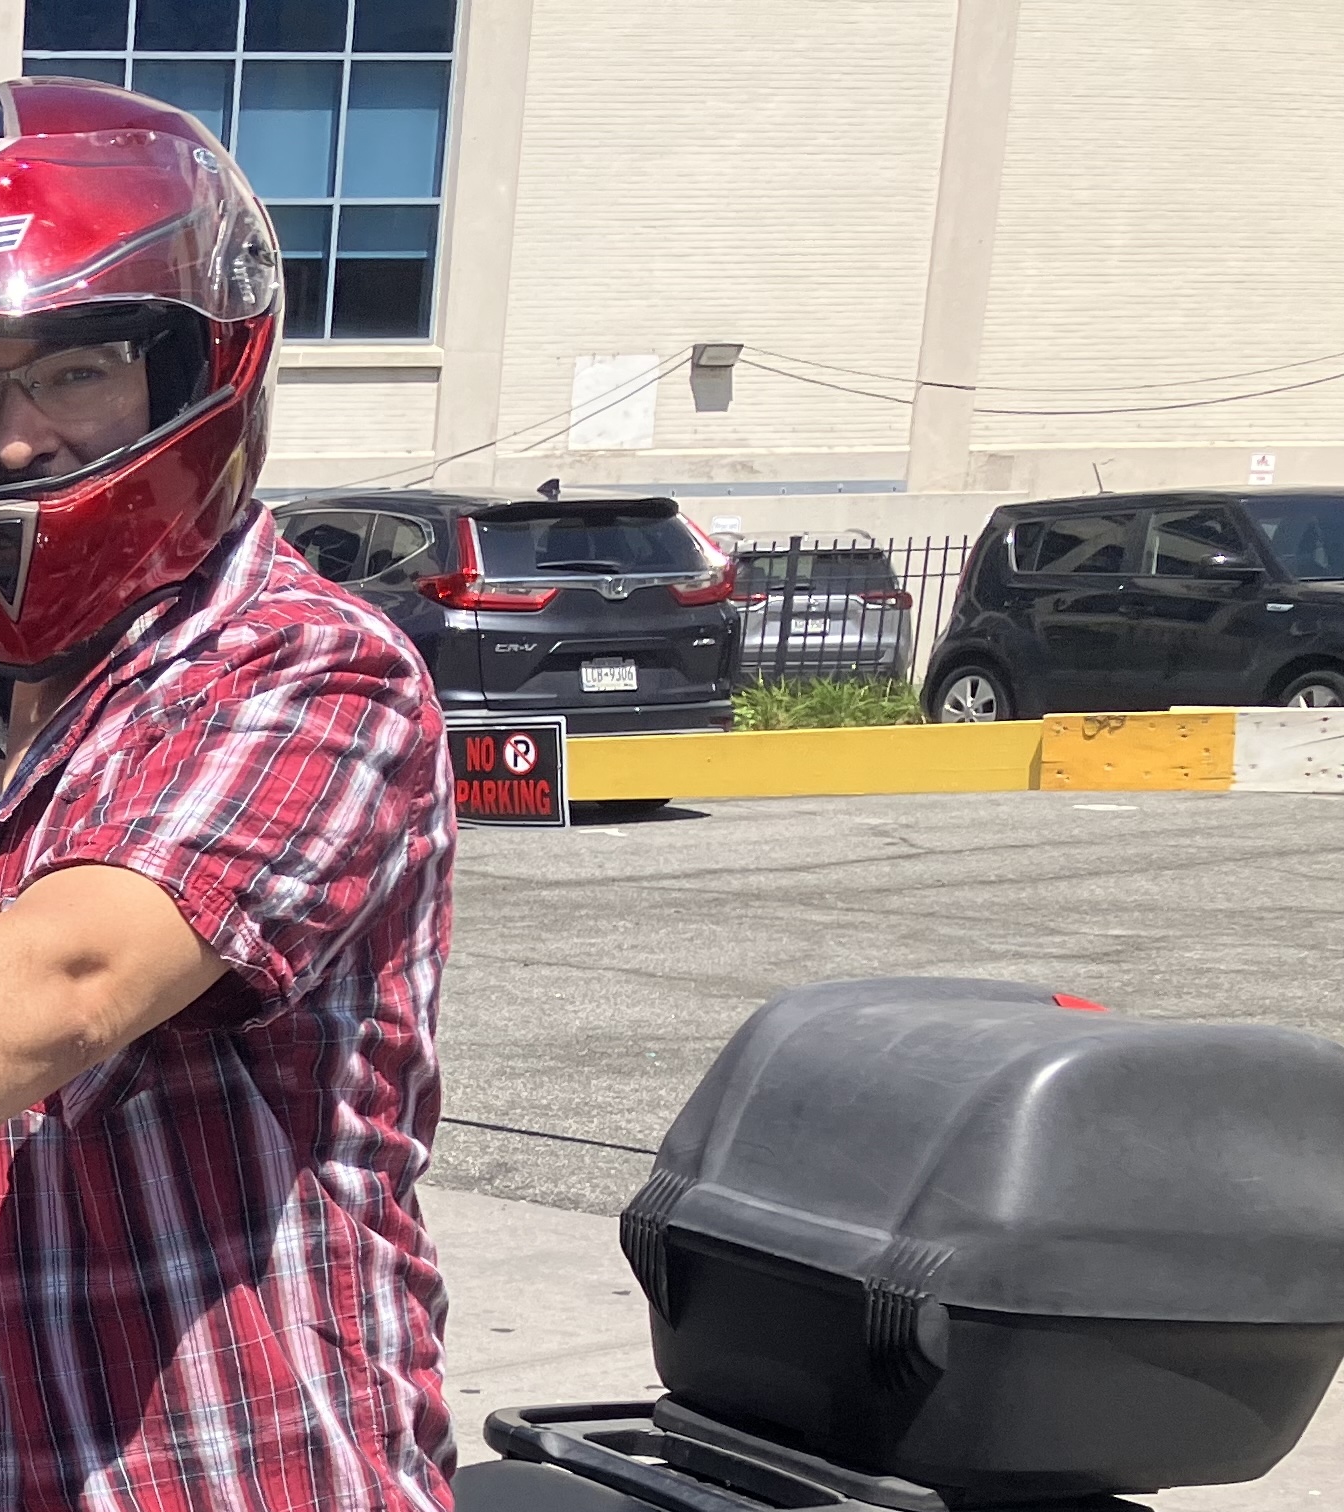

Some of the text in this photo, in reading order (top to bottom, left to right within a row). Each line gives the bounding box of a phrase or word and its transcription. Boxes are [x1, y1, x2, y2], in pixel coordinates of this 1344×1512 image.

[495, 643, 538, 653] CR-V
[465, 735, 496, 772] NO
[456, 779, 551, 816] PARKING
